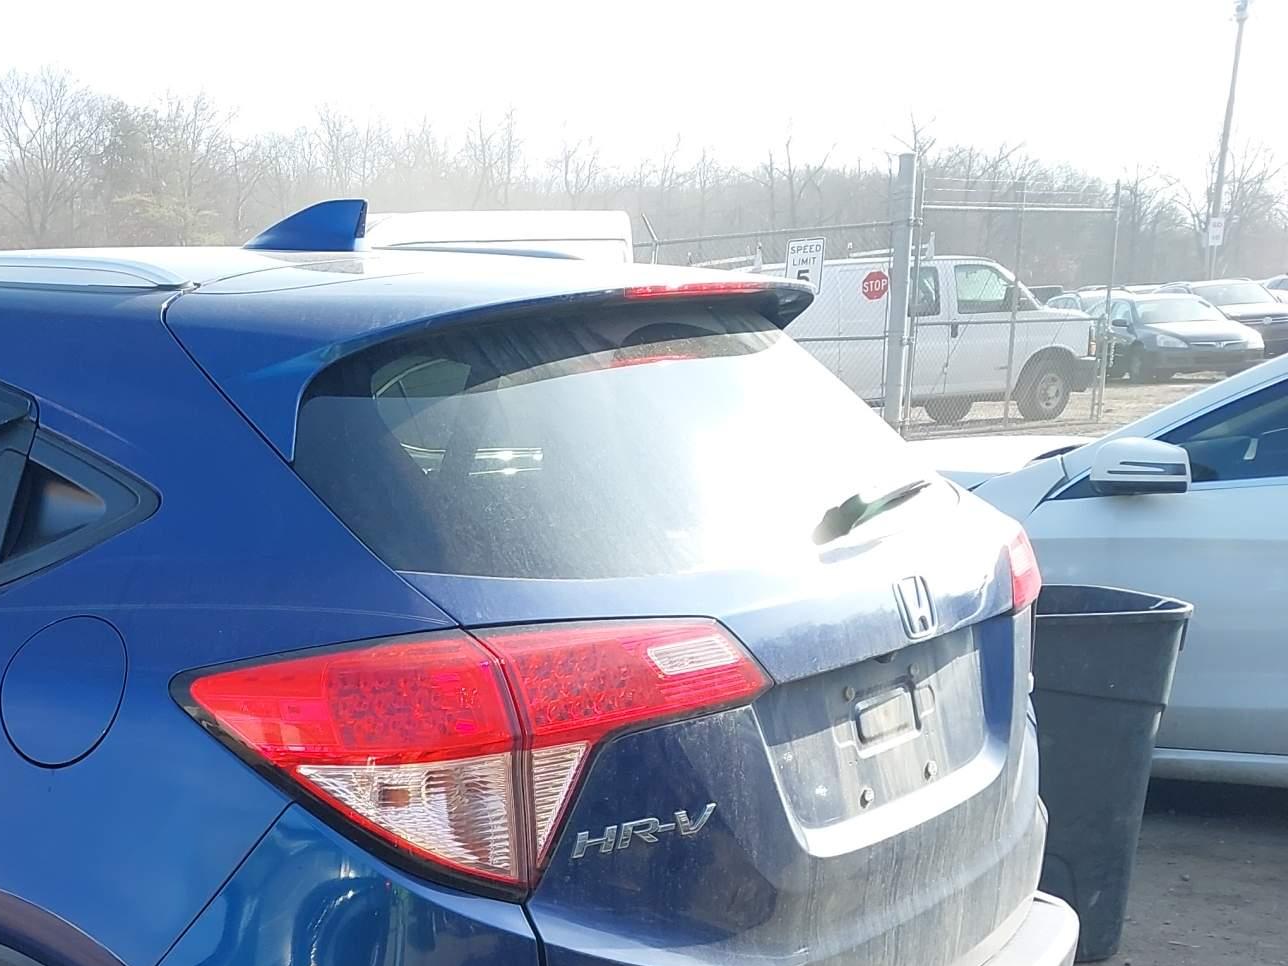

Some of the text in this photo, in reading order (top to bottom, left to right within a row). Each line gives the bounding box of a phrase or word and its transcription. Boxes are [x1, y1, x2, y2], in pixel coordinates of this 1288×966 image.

[790, 244, 822, 254] SPEED
[792, 256, 817, 267] LIMIT
[863, 278, 888, 293] STOP
[571, 802, 717, 859] HR-V
